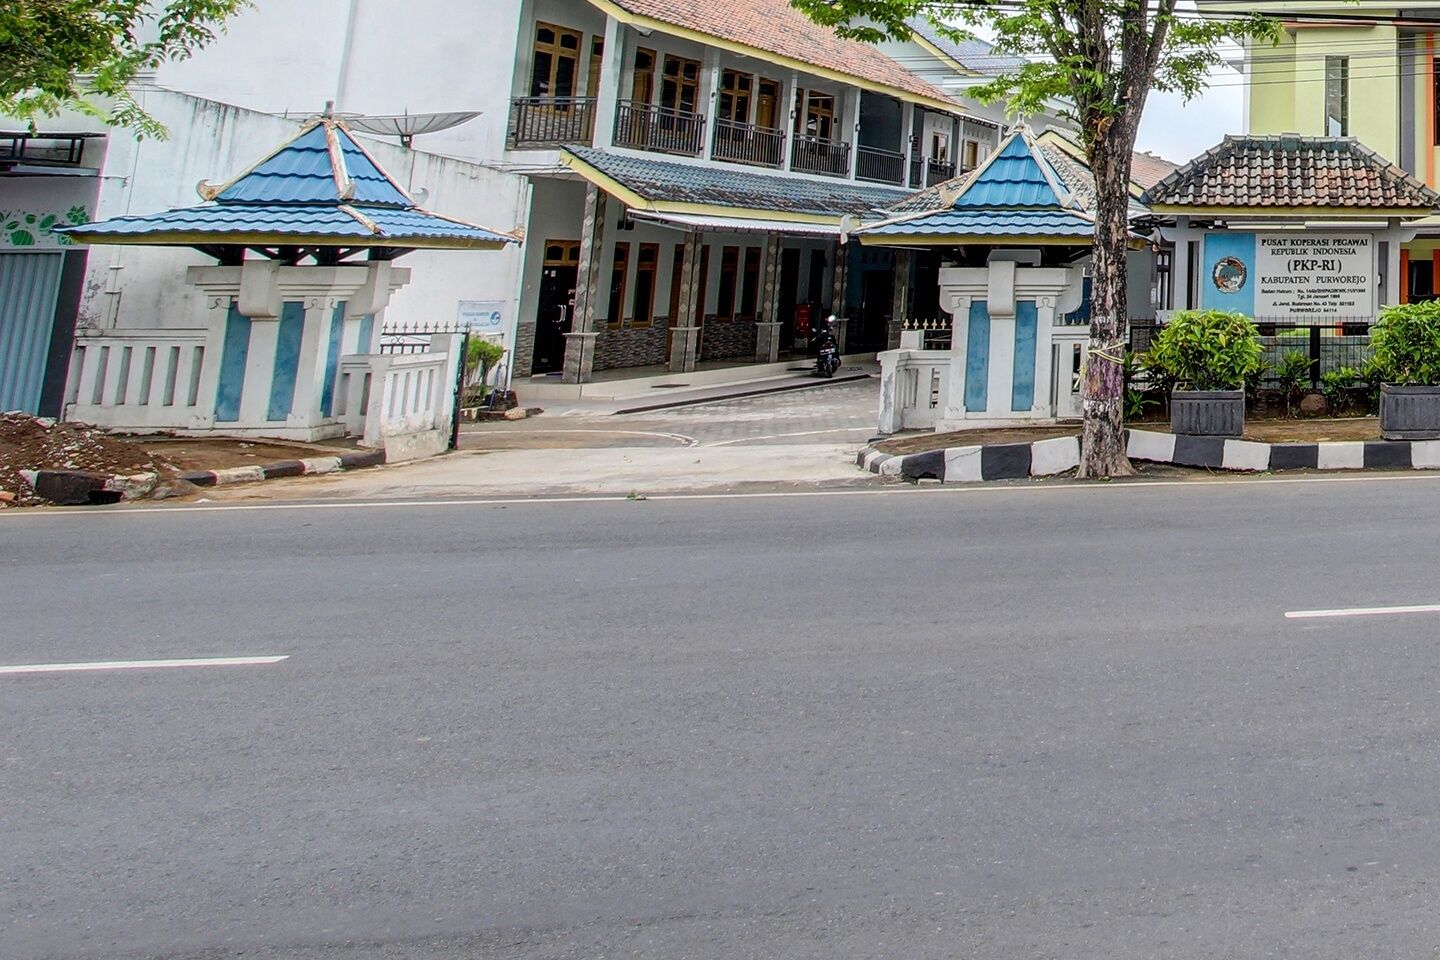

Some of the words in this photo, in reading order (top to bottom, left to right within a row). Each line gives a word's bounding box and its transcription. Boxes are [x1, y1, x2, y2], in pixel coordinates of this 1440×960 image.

[1261, 238, 1288, 246] PUSAT
[1290, 238, 1330, 246] KOPERASI
[1332, 238, 1368, 246] PEGAWAI
[1271, 248, 1308, 256] REPUBLIK
[1313, 248, 1356, 256] INDONESIA
[1261, 276, 1310, 284] KABUPATEN
[1316, 276, 1366, 285] PURWOREJO
